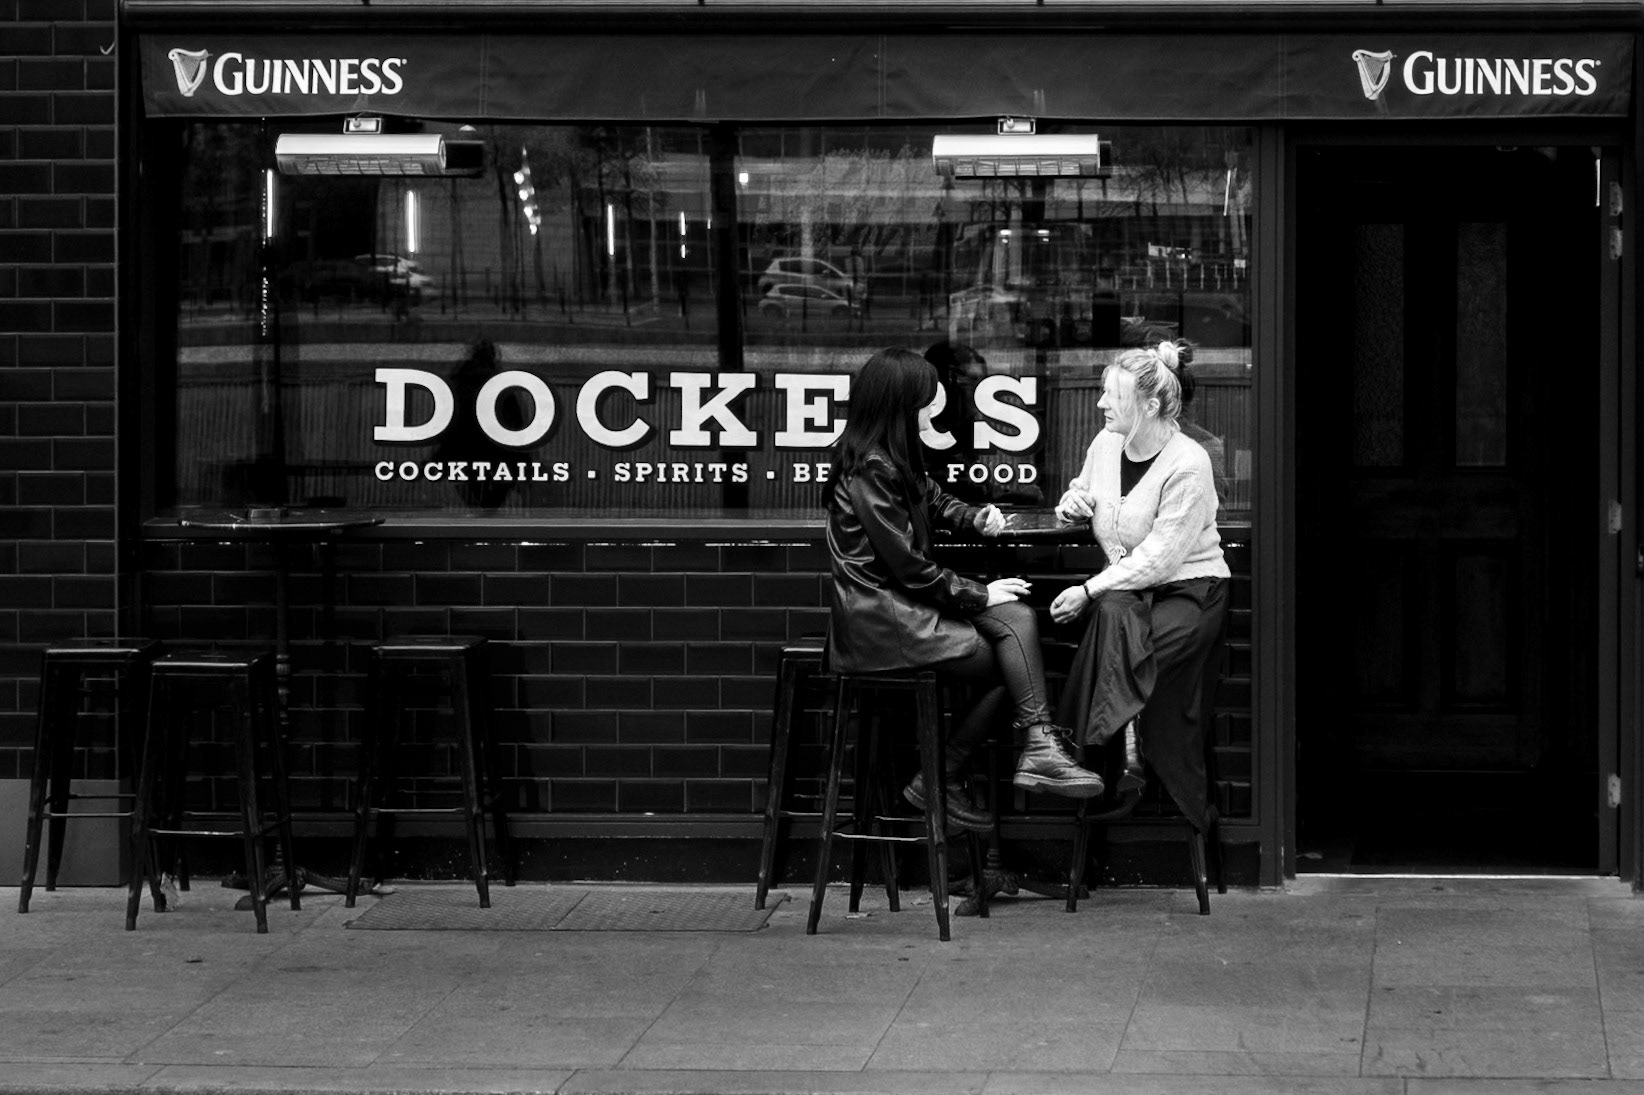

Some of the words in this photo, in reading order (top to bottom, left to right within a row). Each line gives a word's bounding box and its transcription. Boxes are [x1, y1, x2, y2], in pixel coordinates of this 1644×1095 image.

[212, 52, 404, 96] GUINNESS
[1402, 50, 1598, 96] GUINNESS
[374, 461, 570, 482] COCKTAILS
[614, 462, 748, 483] SPIRITS
[946, 462, 1038, 484] FOOD
